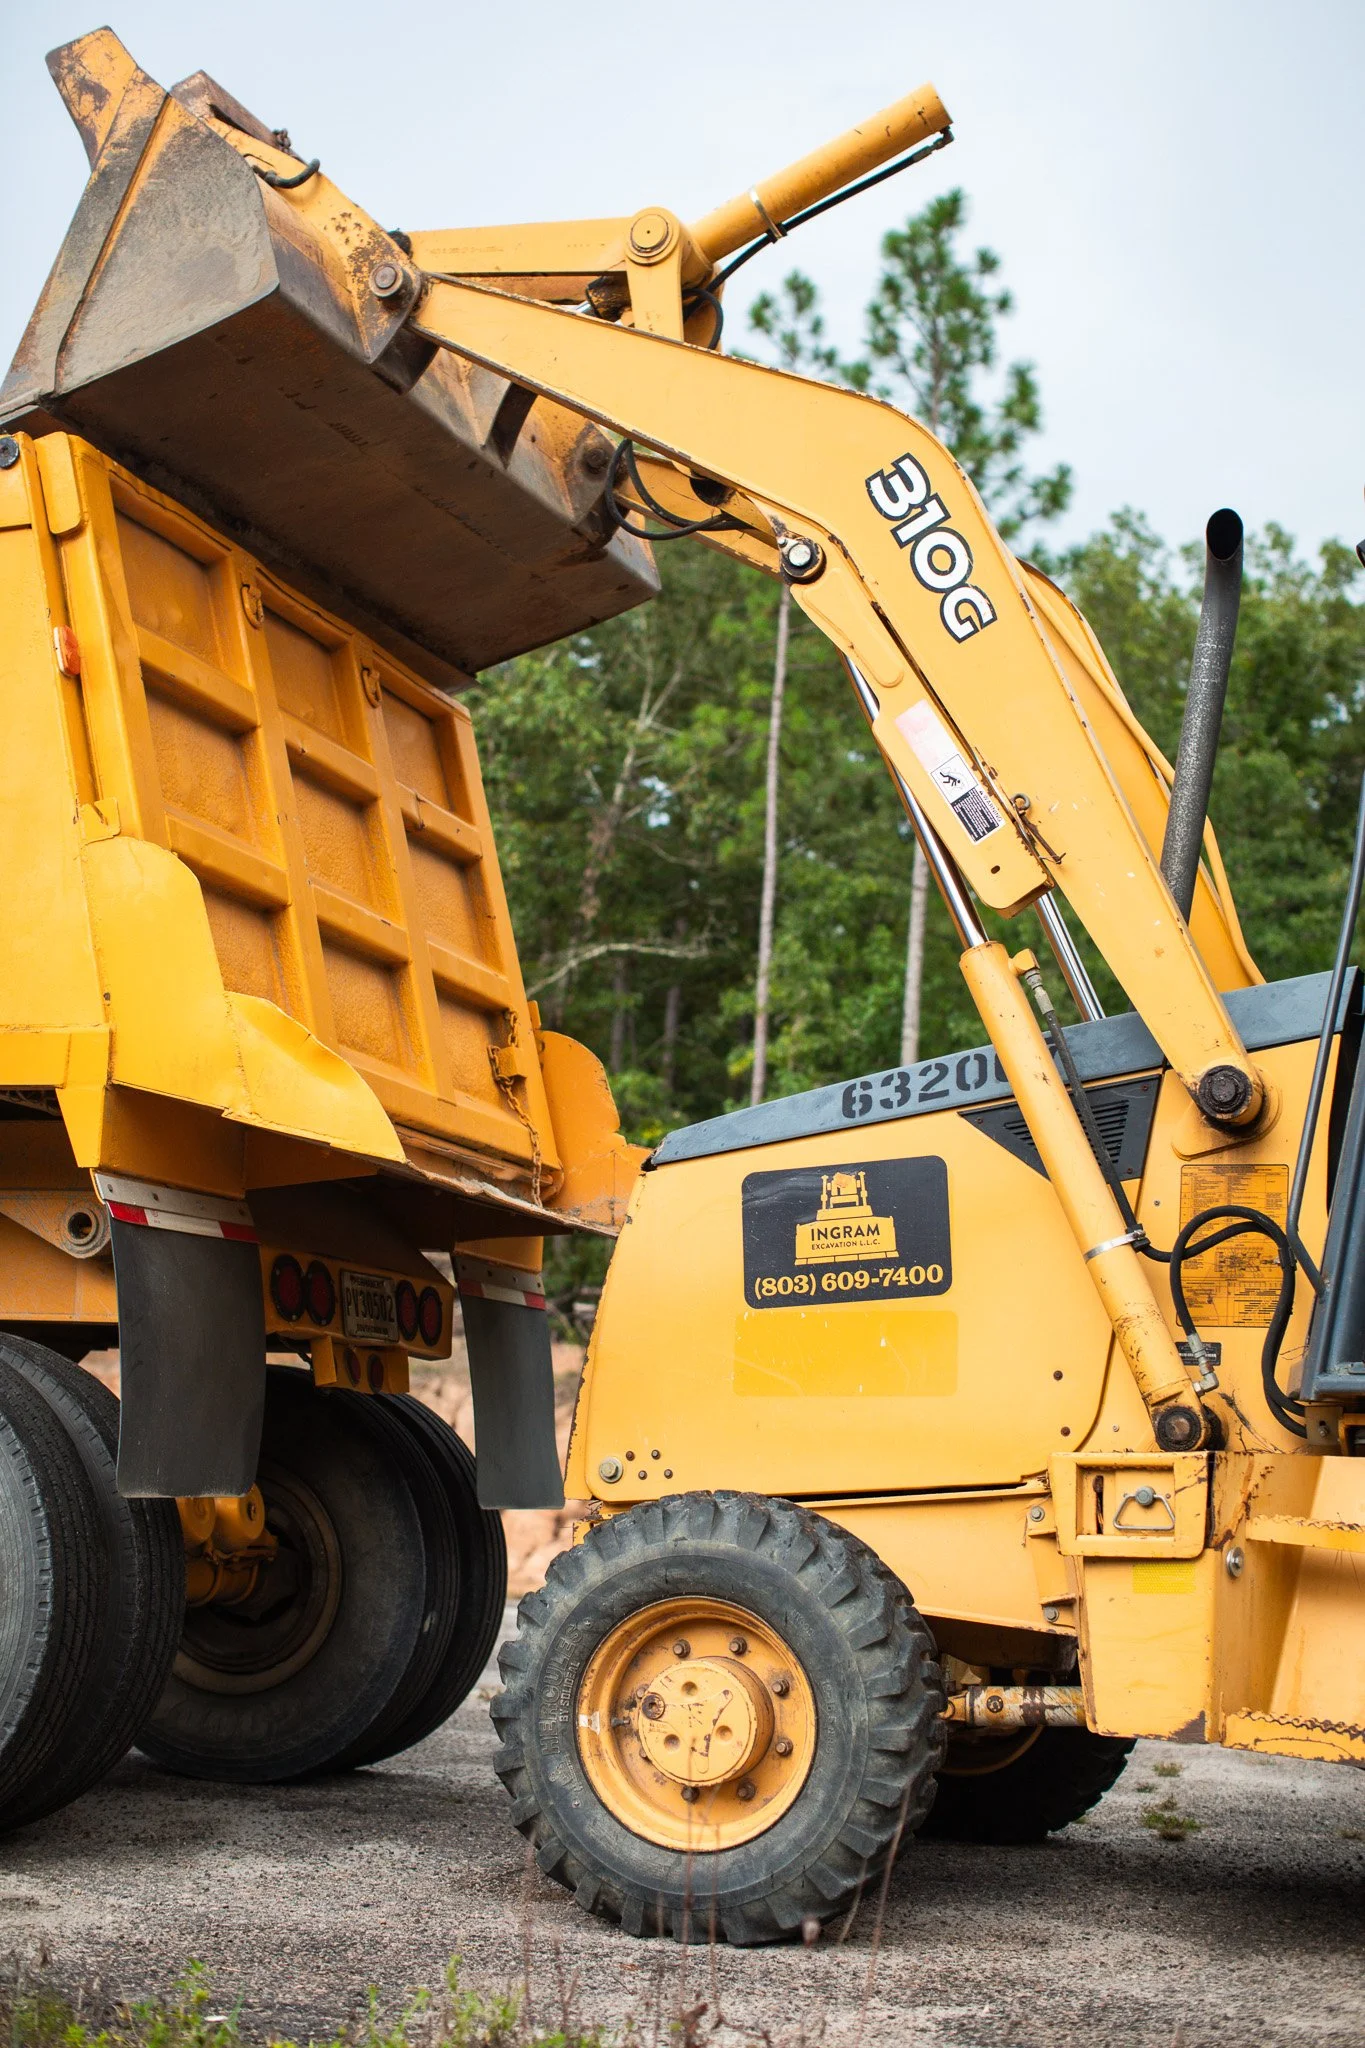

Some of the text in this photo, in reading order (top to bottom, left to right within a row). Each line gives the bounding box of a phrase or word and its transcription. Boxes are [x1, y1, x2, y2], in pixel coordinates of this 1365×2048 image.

[865, 452, 998, 644] 310G
[811, 1223, 881, 1242] INGRAM
[811, 1238, 881, 1250] EXCAVATION L.L.C.
[754, 1264, 944, 1300] (803) 609-7400
[539, 1624, 583, 1756] HERCULES
[560, 1662, 581, 1722] BY SOLIDEAL
